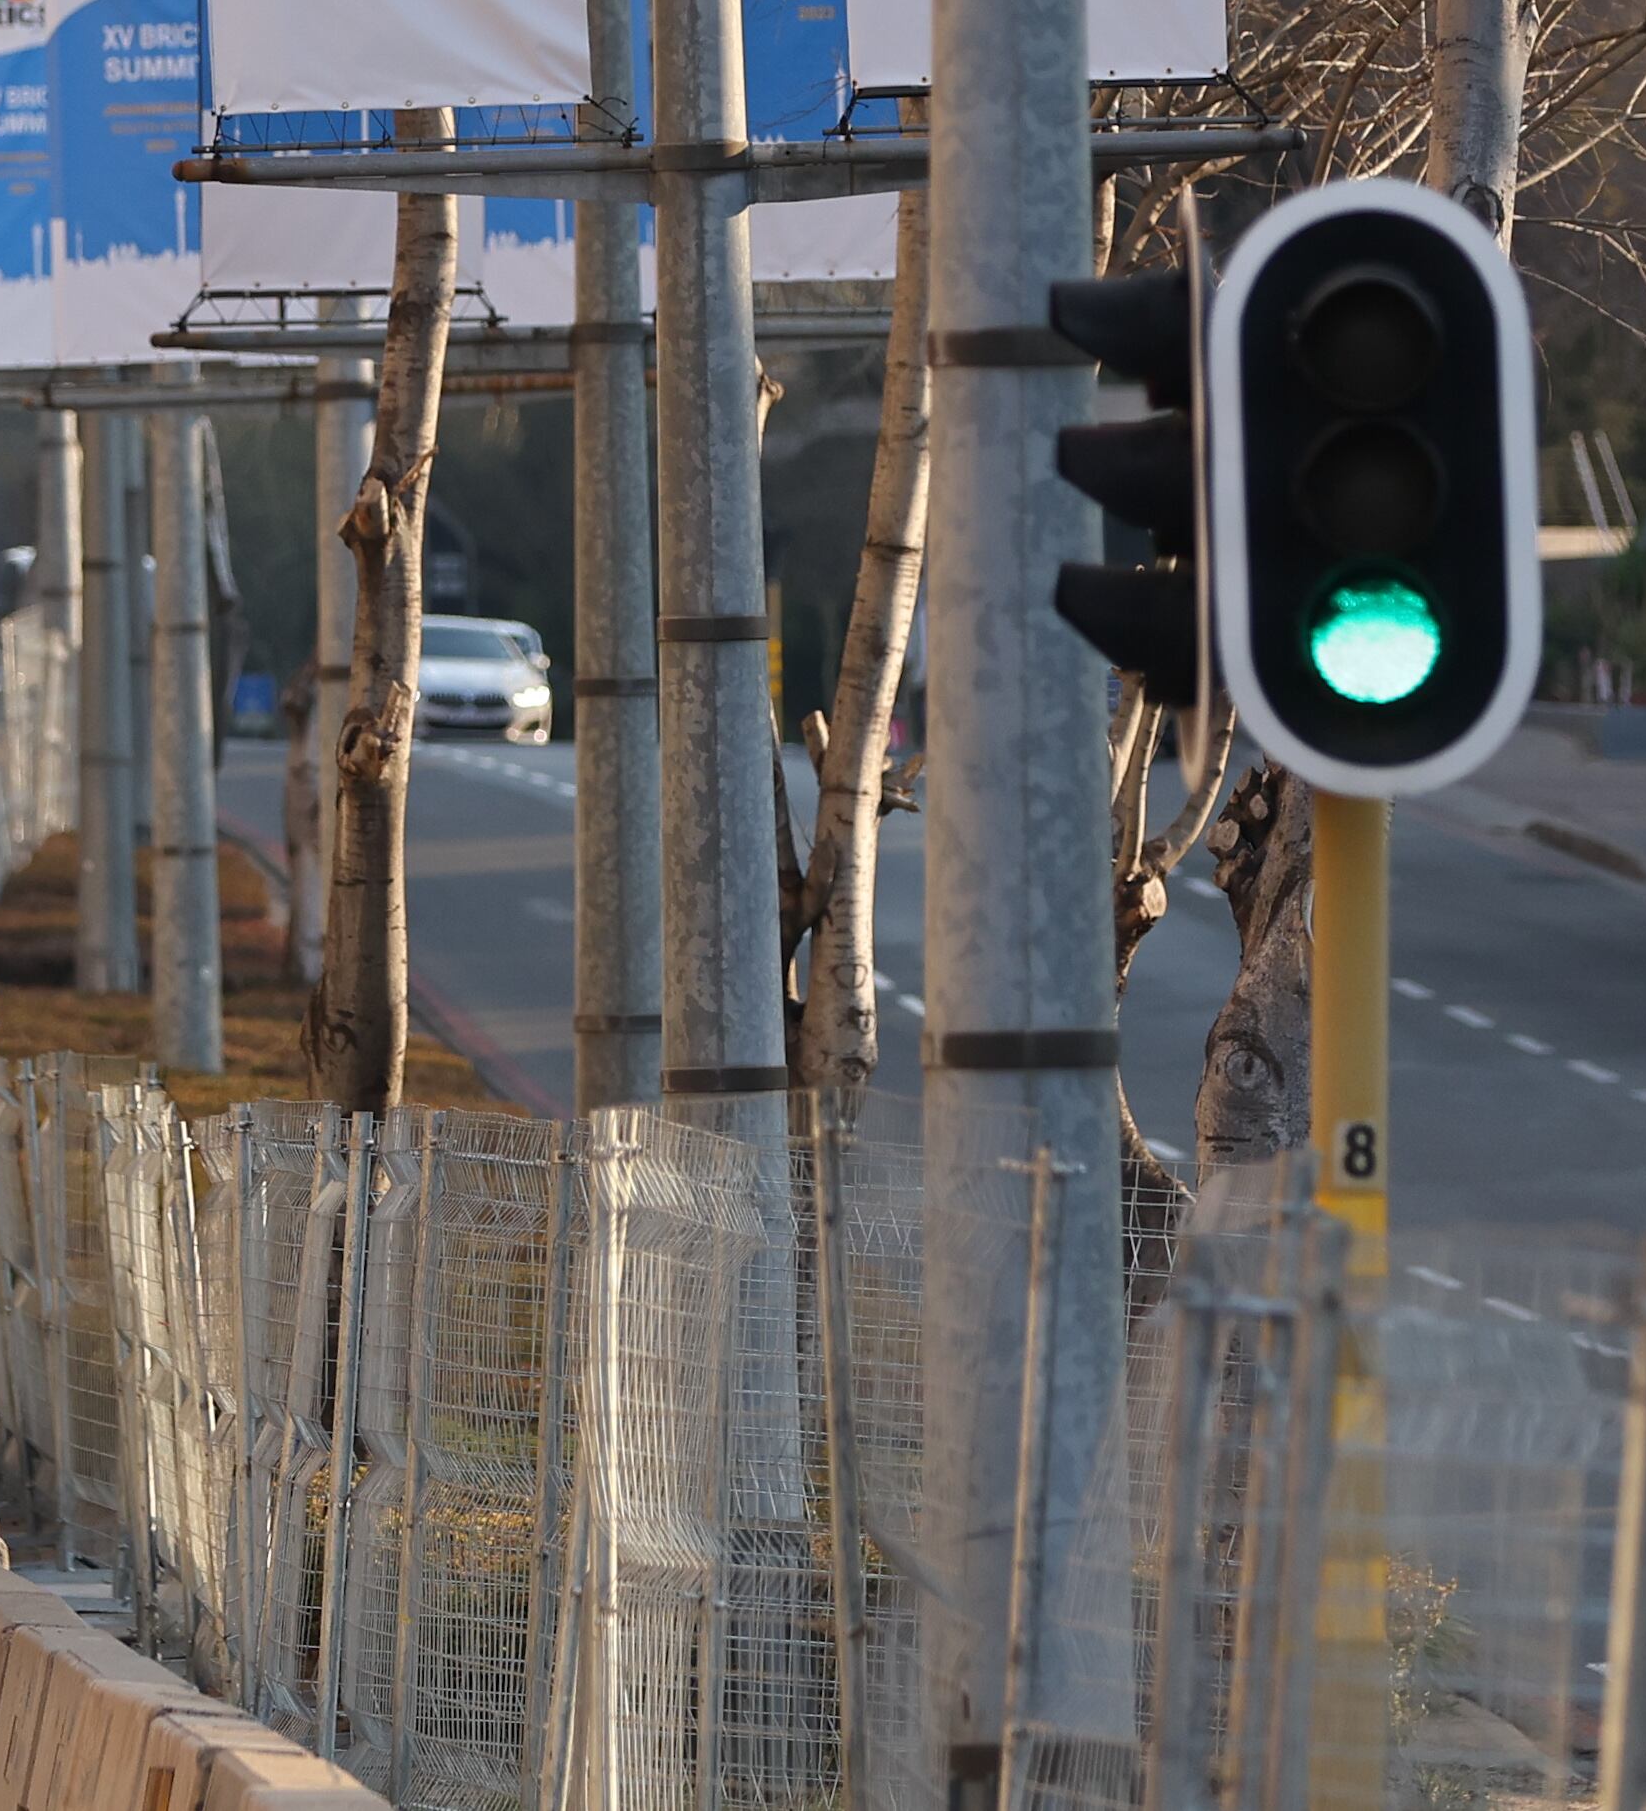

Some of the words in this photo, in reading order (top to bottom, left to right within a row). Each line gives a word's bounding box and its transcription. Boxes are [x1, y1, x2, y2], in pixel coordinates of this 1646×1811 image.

[102, 24, 134, 51] XV
[139, 23, 198, 50] BRIC
[1342, 1124, 1377, 1178] 8
